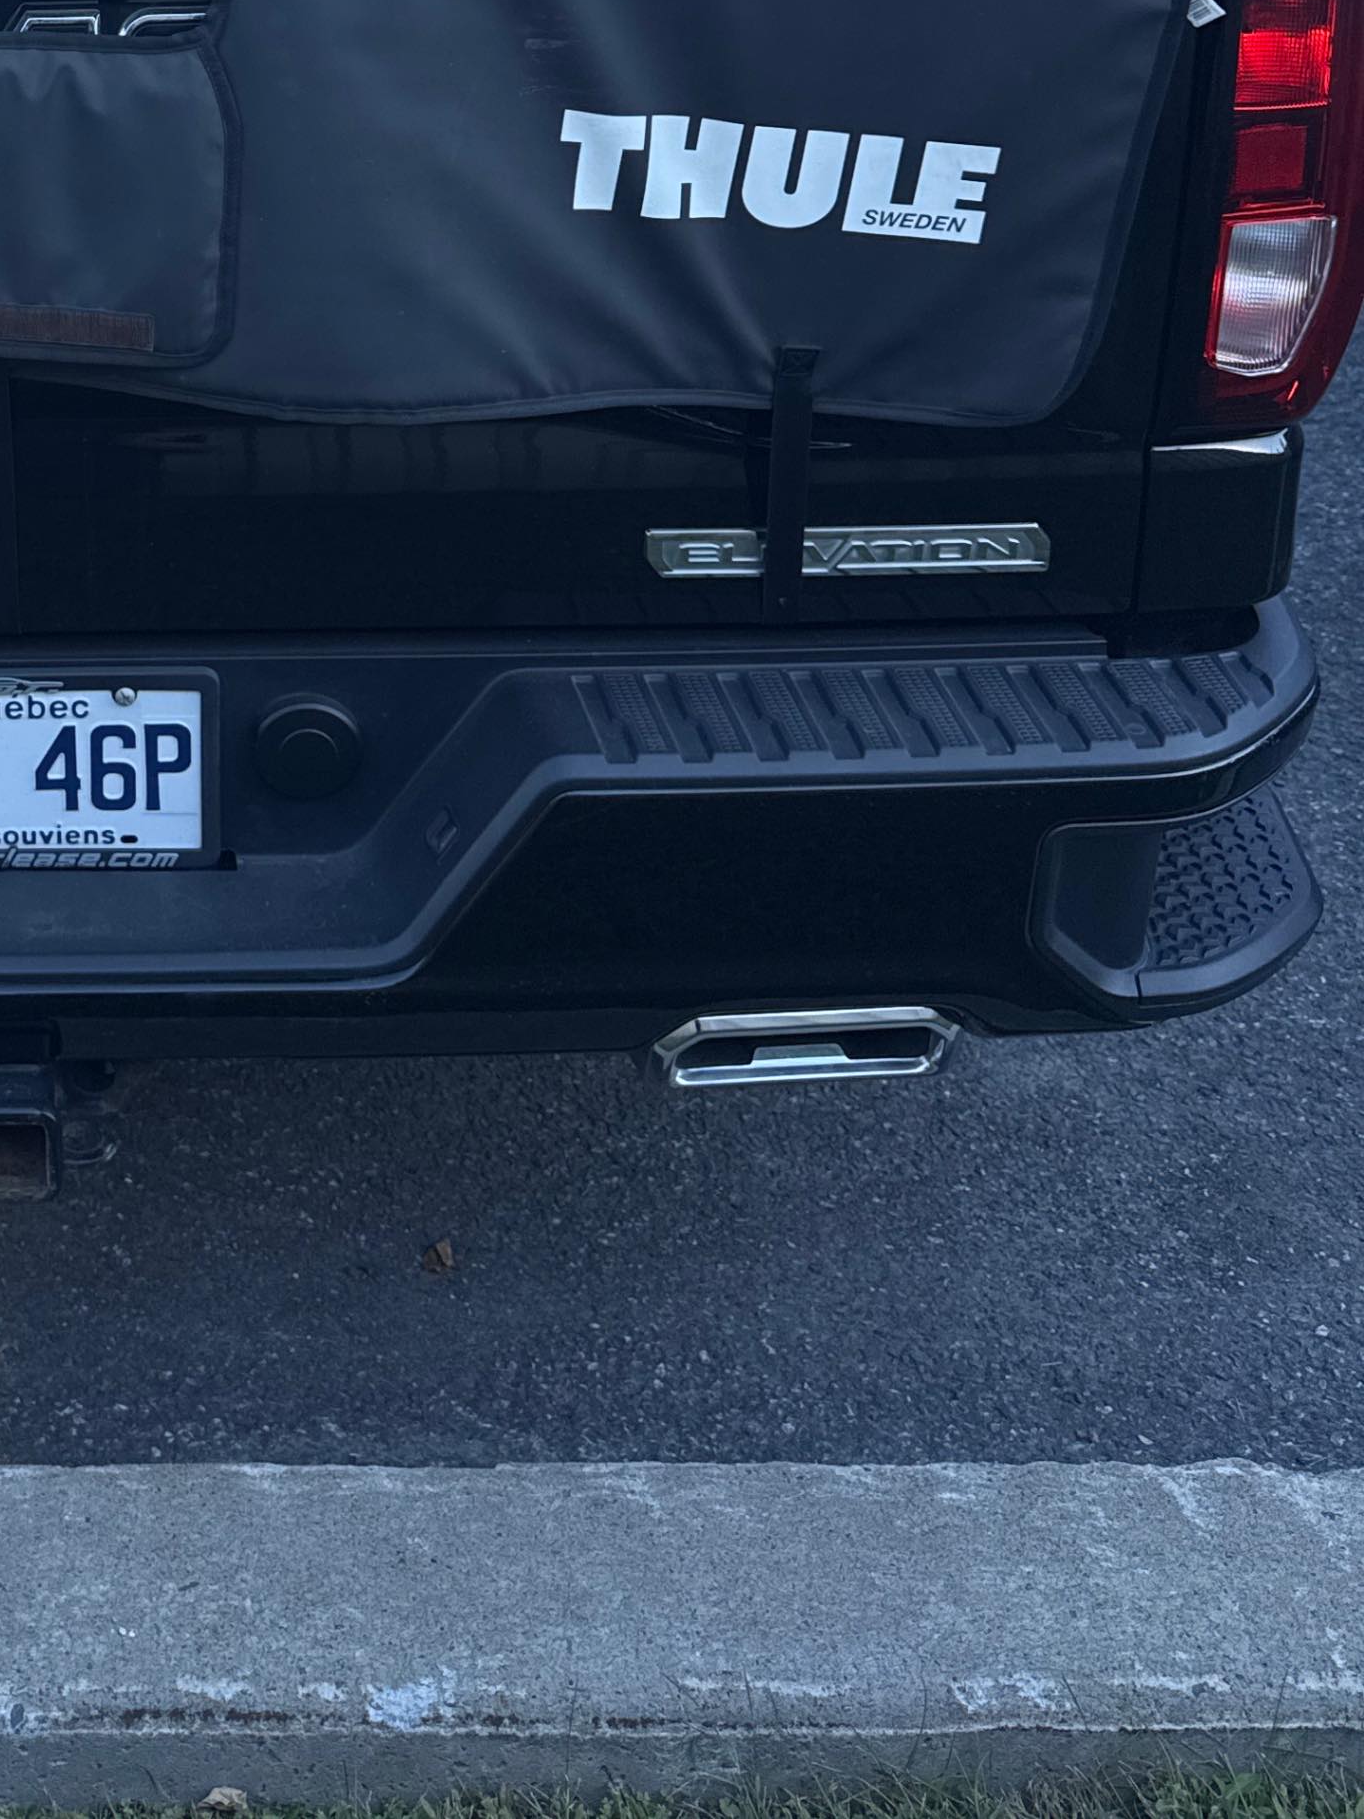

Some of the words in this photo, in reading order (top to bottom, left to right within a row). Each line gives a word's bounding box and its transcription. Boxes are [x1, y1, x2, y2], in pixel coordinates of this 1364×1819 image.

[559, 108, 1002, 244] THULE
[861, 208, 968, 234] SWEDEN
[678, 536, 1021, 565] ELVATION
[33, 723, 192, 813] 46P
